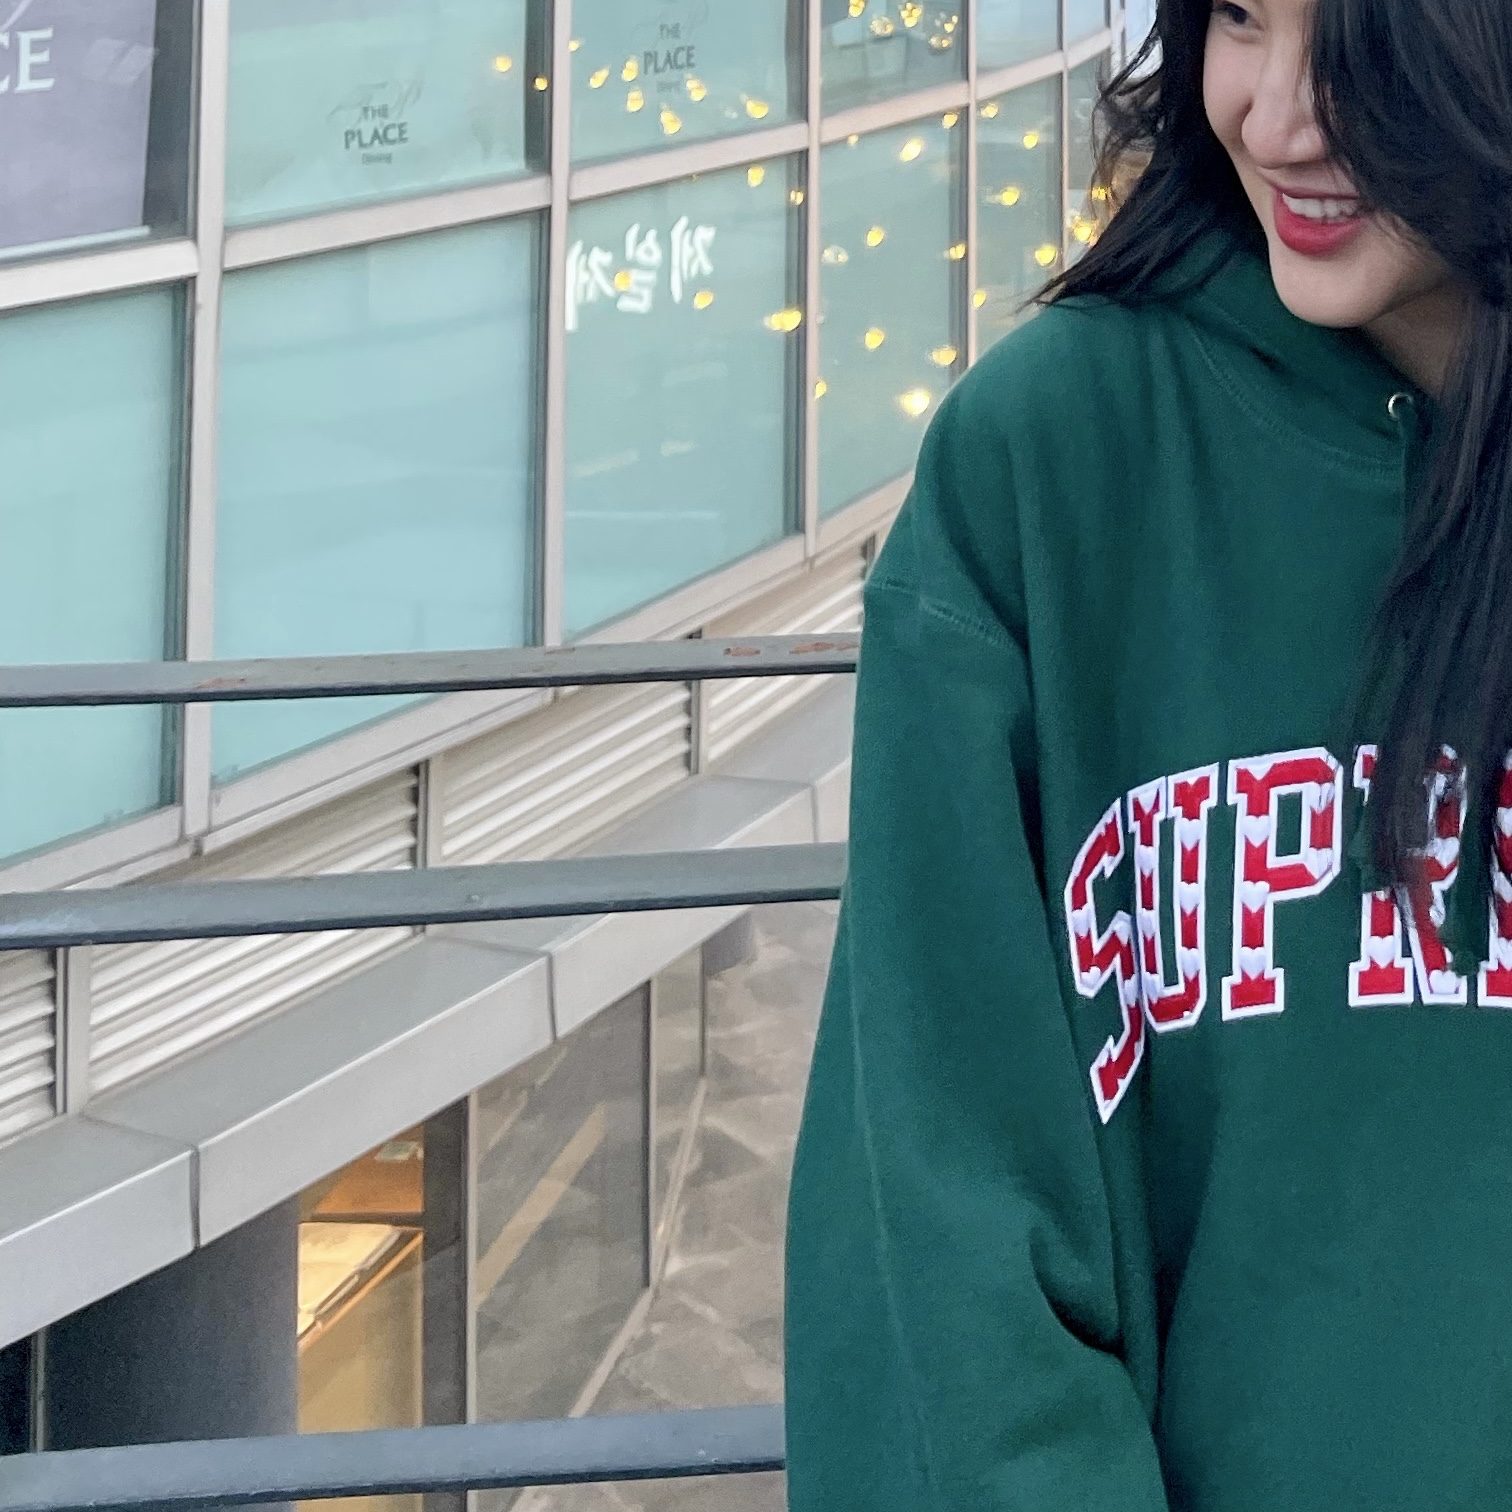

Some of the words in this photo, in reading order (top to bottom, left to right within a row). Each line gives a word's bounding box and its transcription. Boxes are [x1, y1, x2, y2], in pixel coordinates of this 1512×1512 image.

[643, 44, 696, 76] PLACE
[362, 103, 389, 120] THE
[343, 121, 410, 151] PLACE
